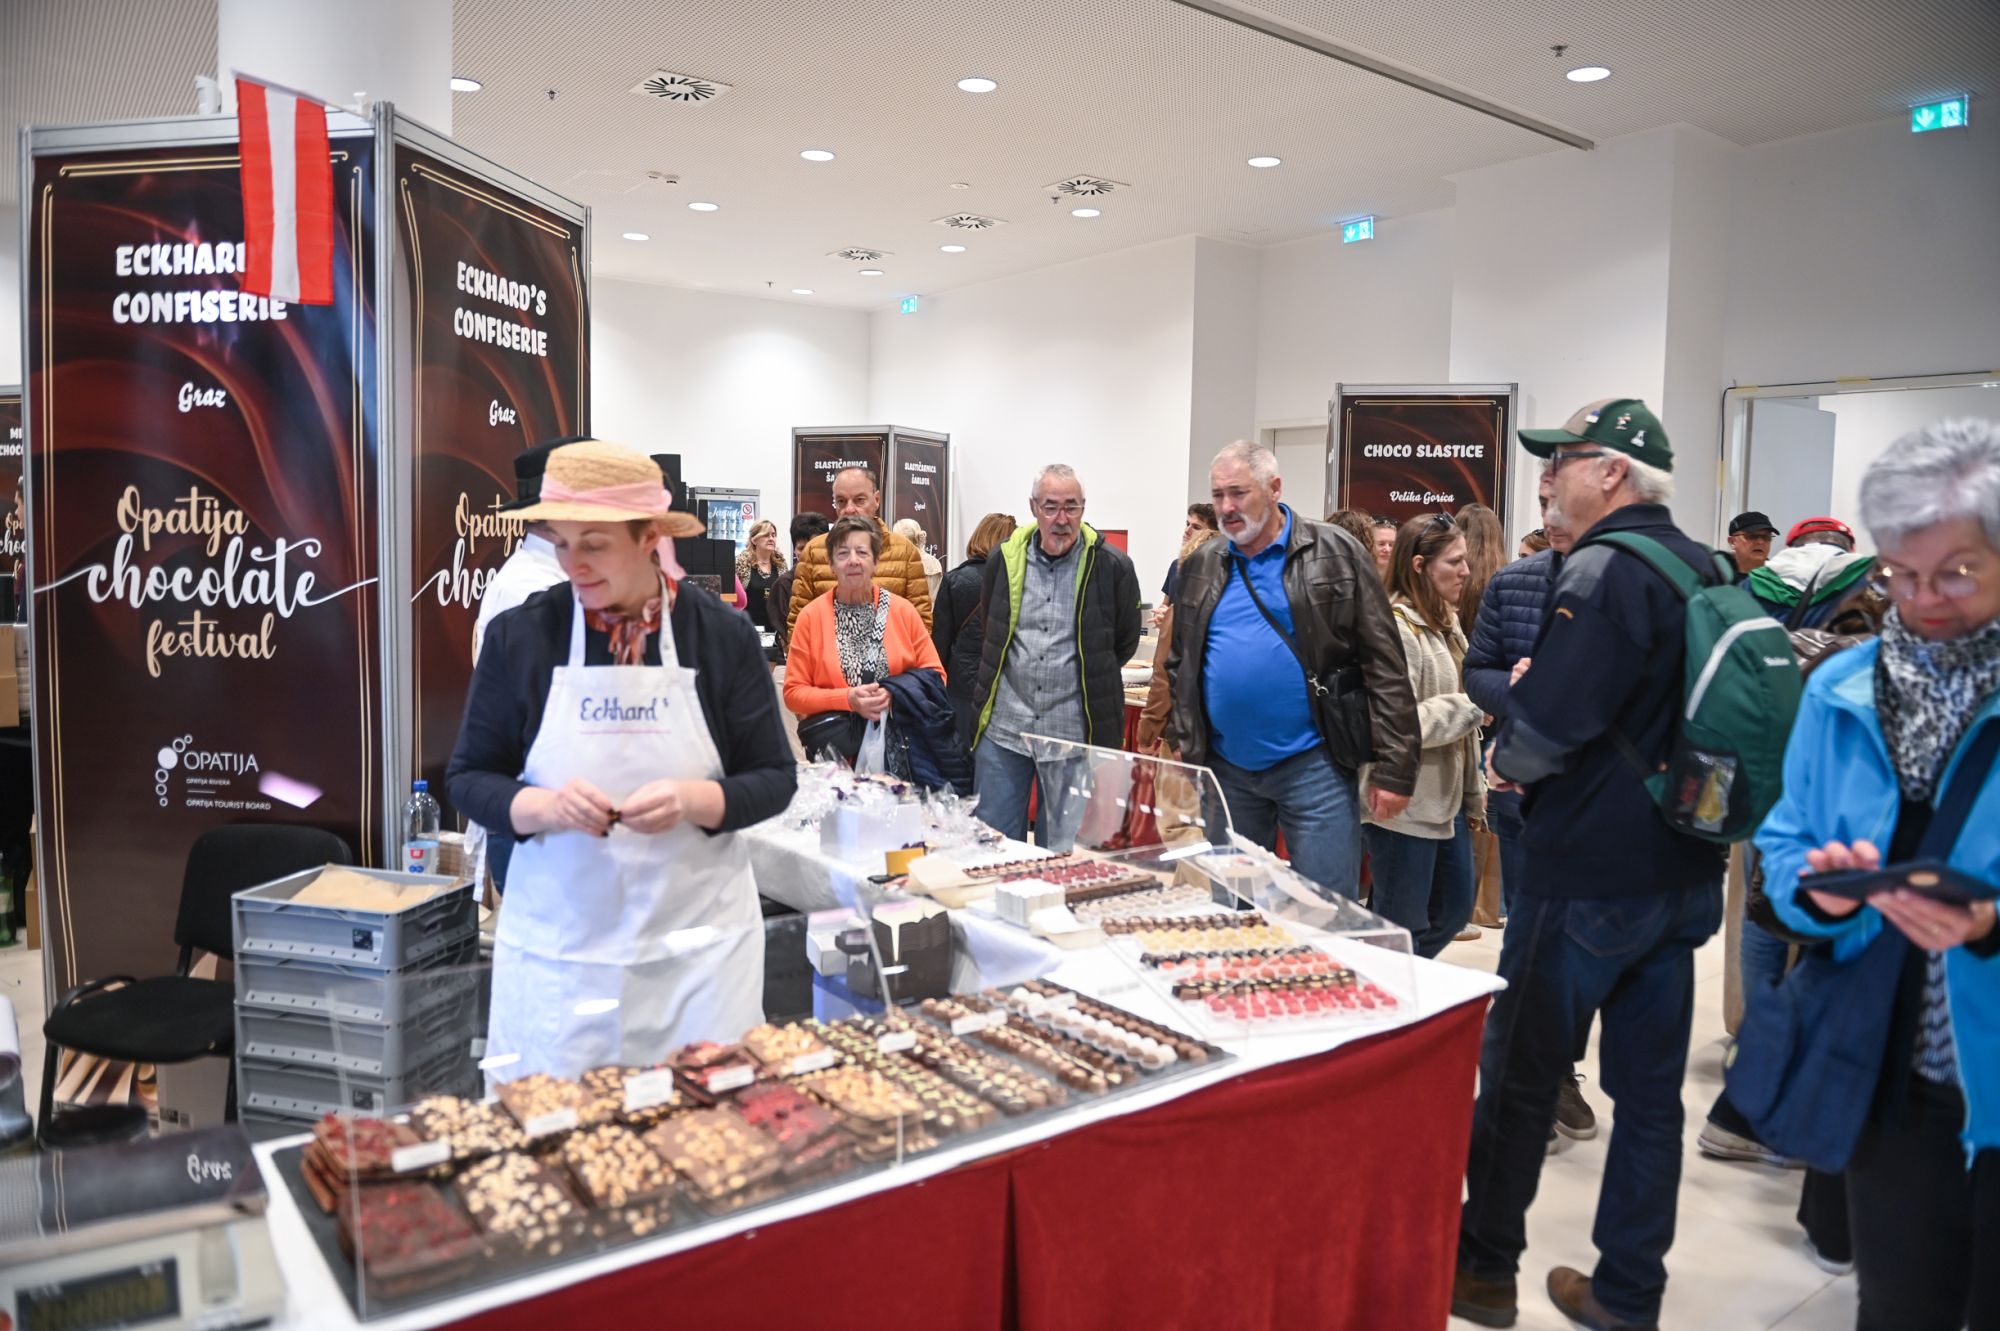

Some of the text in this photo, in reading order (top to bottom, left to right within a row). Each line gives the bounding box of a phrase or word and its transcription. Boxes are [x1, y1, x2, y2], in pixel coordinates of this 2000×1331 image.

[457, 260, 547, 316] ECKHARD'S
[112, 290, 288, 324] CONFISERIE
[454, 307, 547, 357] CONFISERIE
[178, 382, 226, 413] Graz
[489, 399, 516, 427] Graz
[1363, 444, 1484, 458] CHOCO SLASTICE
[1389, 491, 1455, 505] Velika Gorica
[117, 485, 249, 557] Opatija
[34, 533, 379, 619] chocolate
[146, 609, 276, 678] festival
[184, 752, 259, 775] OPATIJA
[185, 799, 272, 811] OPATIJA TOURIST BOARD
